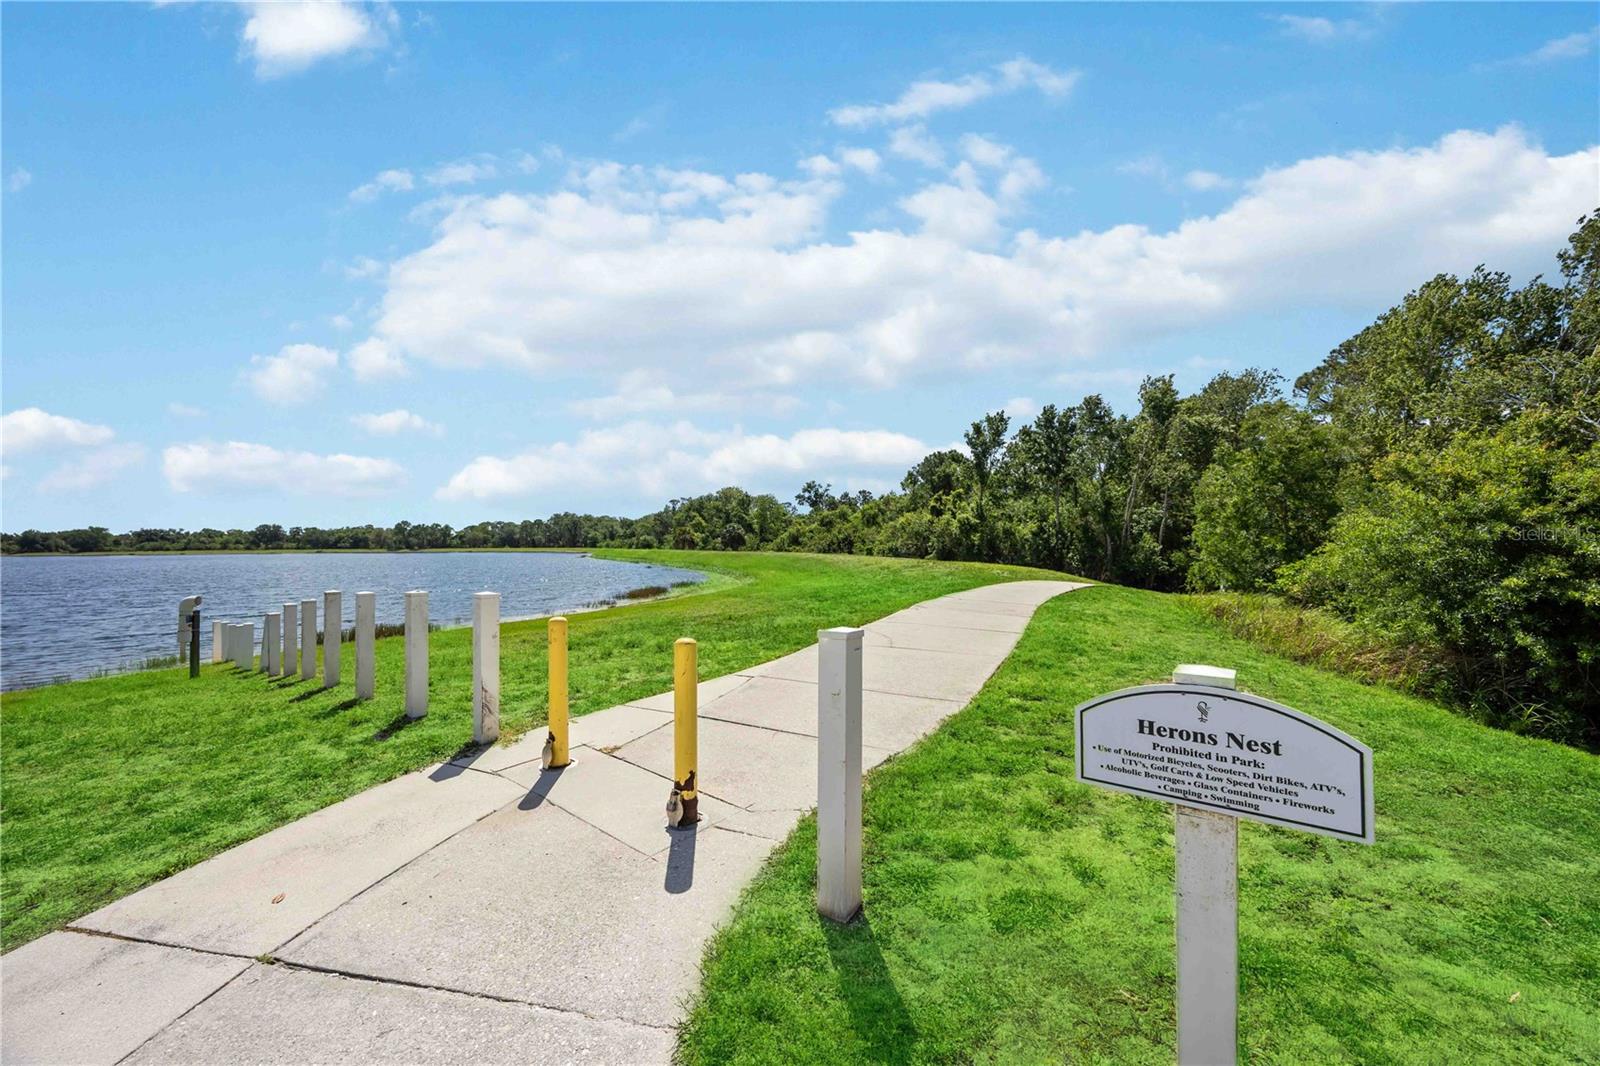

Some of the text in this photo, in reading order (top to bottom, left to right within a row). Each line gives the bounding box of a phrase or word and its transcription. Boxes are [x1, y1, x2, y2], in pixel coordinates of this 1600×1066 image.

[1137, 719, 1282, 756] Herons Nest
[1152, 742, 1265, 769] Prohibited in Park:
[1098, 744, 1346, 796] Use of Motorized Bicycles, Scooters, Dirt Bikes, ATV's,
[1121, 758, 1149, 769] UTV's,
[1150, 763, 1169, 773] Golf
[1170, 767, 1194, 778] Carts
[1205, 773, 1223, 783] Low
[1226, 777, 1255, 789] Speed
[1257, 783, 1299, 797] Vehicles
[1105, 764, 1335, 815] Alcoholic Beverages Glass Containers Fireworks
[1163, 785, 1260, 811] Camping Swimming
